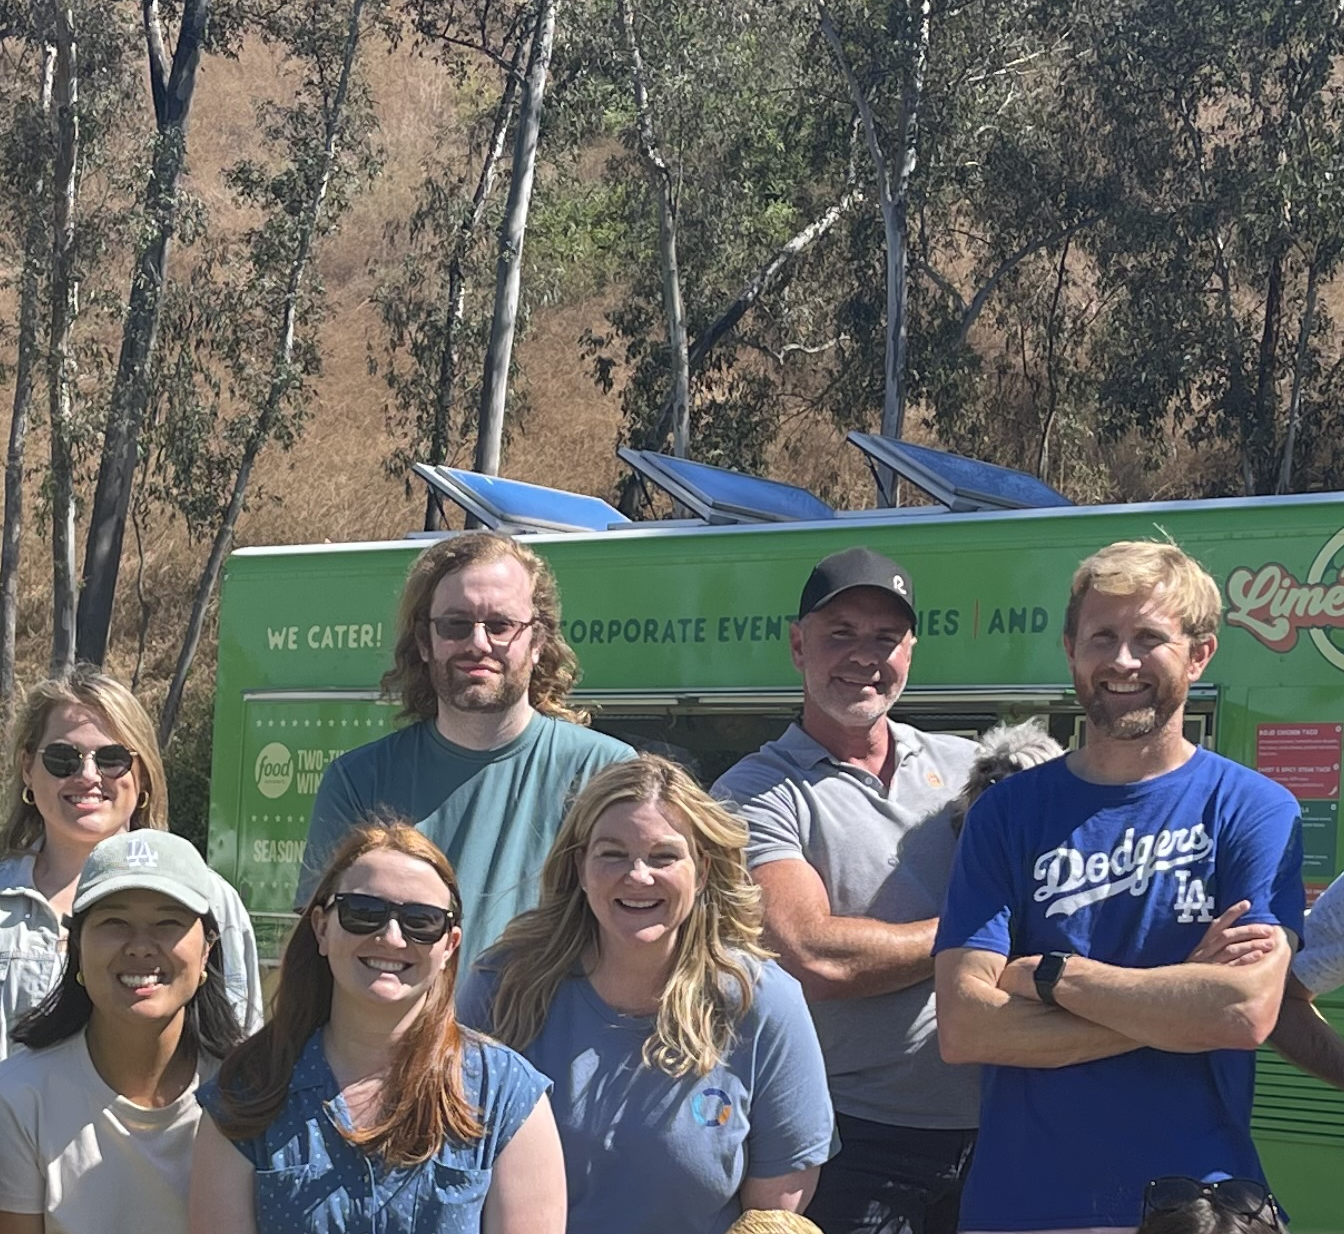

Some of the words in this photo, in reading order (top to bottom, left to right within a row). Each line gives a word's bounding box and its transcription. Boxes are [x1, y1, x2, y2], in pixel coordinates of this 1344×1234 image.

[893, 574, 907, 595] R
[267, 626, 299, 650] WE
[307, 623, 382, 649] CATER!
[560, 617, 707, 644] ORPORATE
[988, 606, 1049, 635] AND
[257, 754, 293, 785] food
[126, 838, 159, 868] LA
[1033, 822, 1213, 918] Dodgers
[1174, 869, 1214, 923] LA
